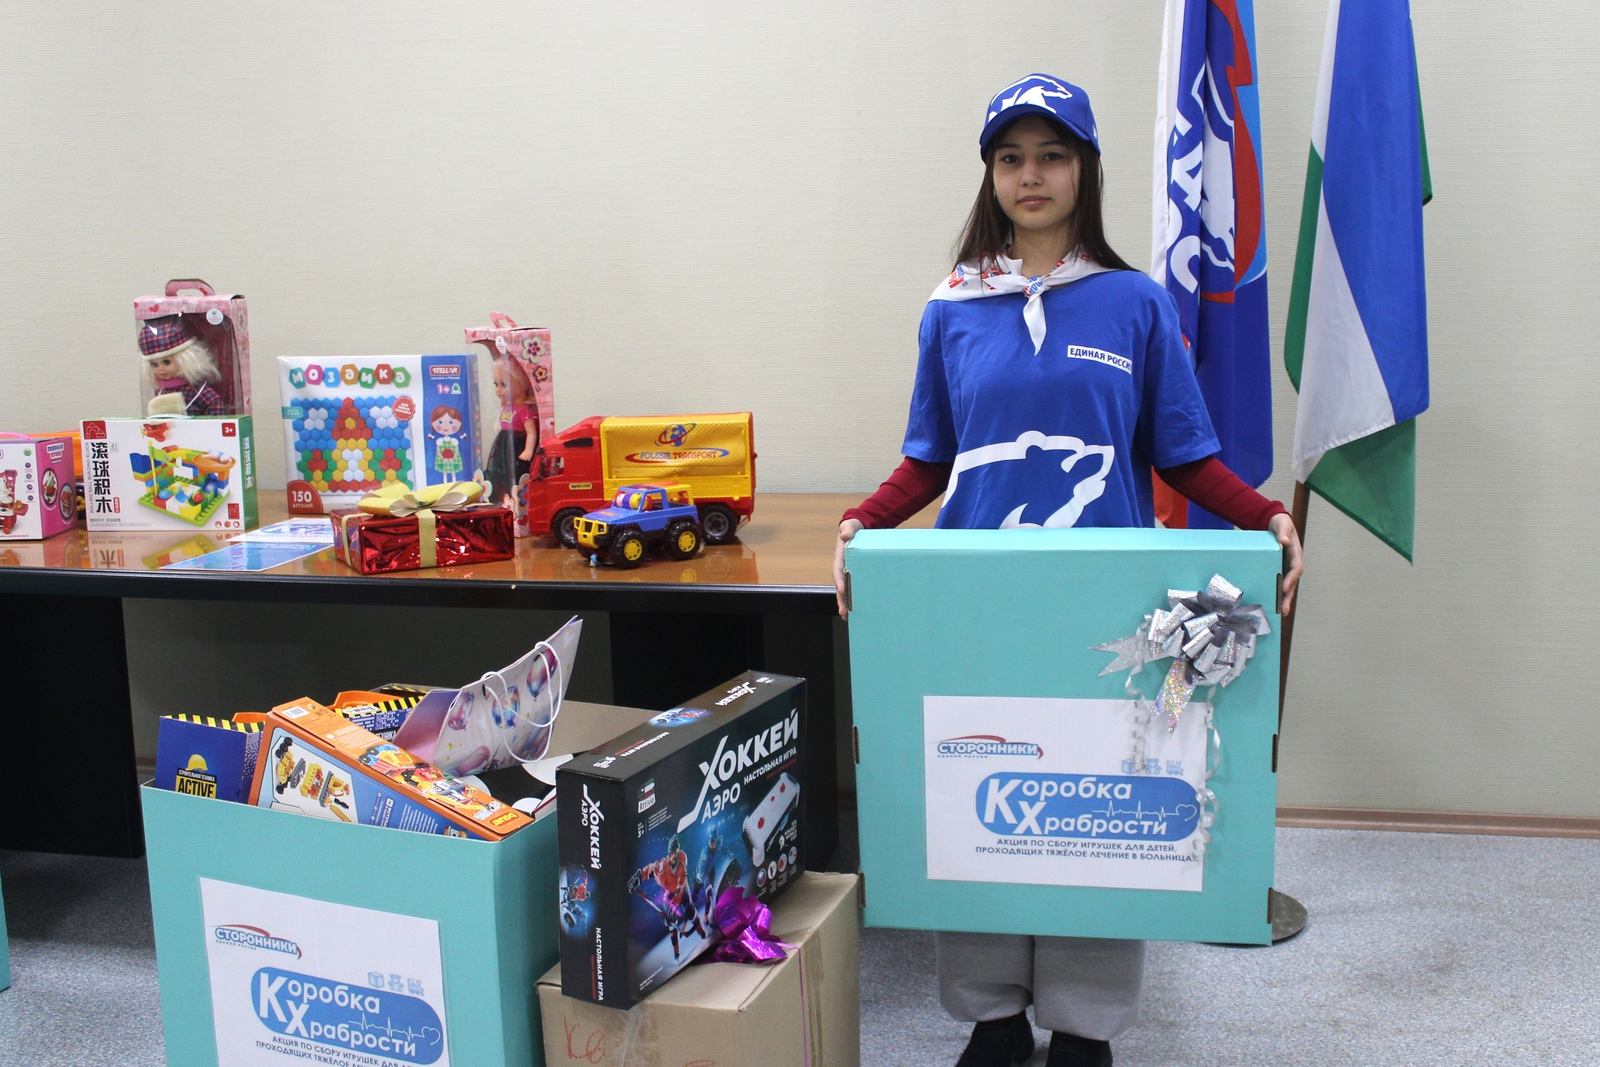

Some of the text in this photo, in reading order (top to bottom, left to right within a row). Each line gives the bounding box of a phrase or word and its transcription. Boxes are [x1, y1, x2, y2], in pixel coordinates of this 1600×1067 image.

[1069, 347, 1106, 361] ЕДИНАЯ
[224, 426, 234, 434] 3+
[640, 450, 718, 460] POLESIE TRANSPORT
[91, 441, 113, 514] 滚球积木
[292, 491, 312, 503] 150
[686, 708, 799, 818] ХОККЕЙ
[937, 742, 1039, 756] СТОРОННИКИ
[743, 755, 783, 786] НАСТОЛЬНАЯ
[782, 746, 798, 762] ИГРА
[177, 777, 215, 798] ACTIVE
[983, 777, 1132, 825] Коробка
[581, 799, 590, 828] АЭРО
[700, 782, 742, 825] АЭРО
[585, 787, 605, 870] ХОККЕЙ
[1013, 800, 1168, 837] Храбрости
[975, 846, 1044, 857] ПРОХОДЯЩИХ
[1045, 849, 1088, 858] ТЯЖЁЛОЕ
[1089, 851, 1130, 860] ЛЕЧЕНИЕ
[996, 838, 1028, 847] АКЦИЯ
[1030, 839, 1045, 848] ПО
[1047, 840, 1079, 849] СБОРУ
[1080, 842, 1123, 851] ИГРУШЕК
[1124, 843, 1145, 852] ДЛЯ
[215, 927, 298, 955] СТОРОННИКИ
[595, 927, 605, 1001] НАСТОЛЬНАЯ ИГРА
[259, 972, 380, 1024] Коробка
[285, 1000, 416, 1057] Храбрости
[255, 1040, 350, 1067] ПРОХОДЯЩИХ ТЯЖЁЛОЕ
[272, 1036, 299, 1047] АКЦИЯ
[300, 1041, 313, 1051] ПО
[314, 1045, 341, 1057] СБОРУ
[343, 1052, 379, 1066] ИГРУШЕК
